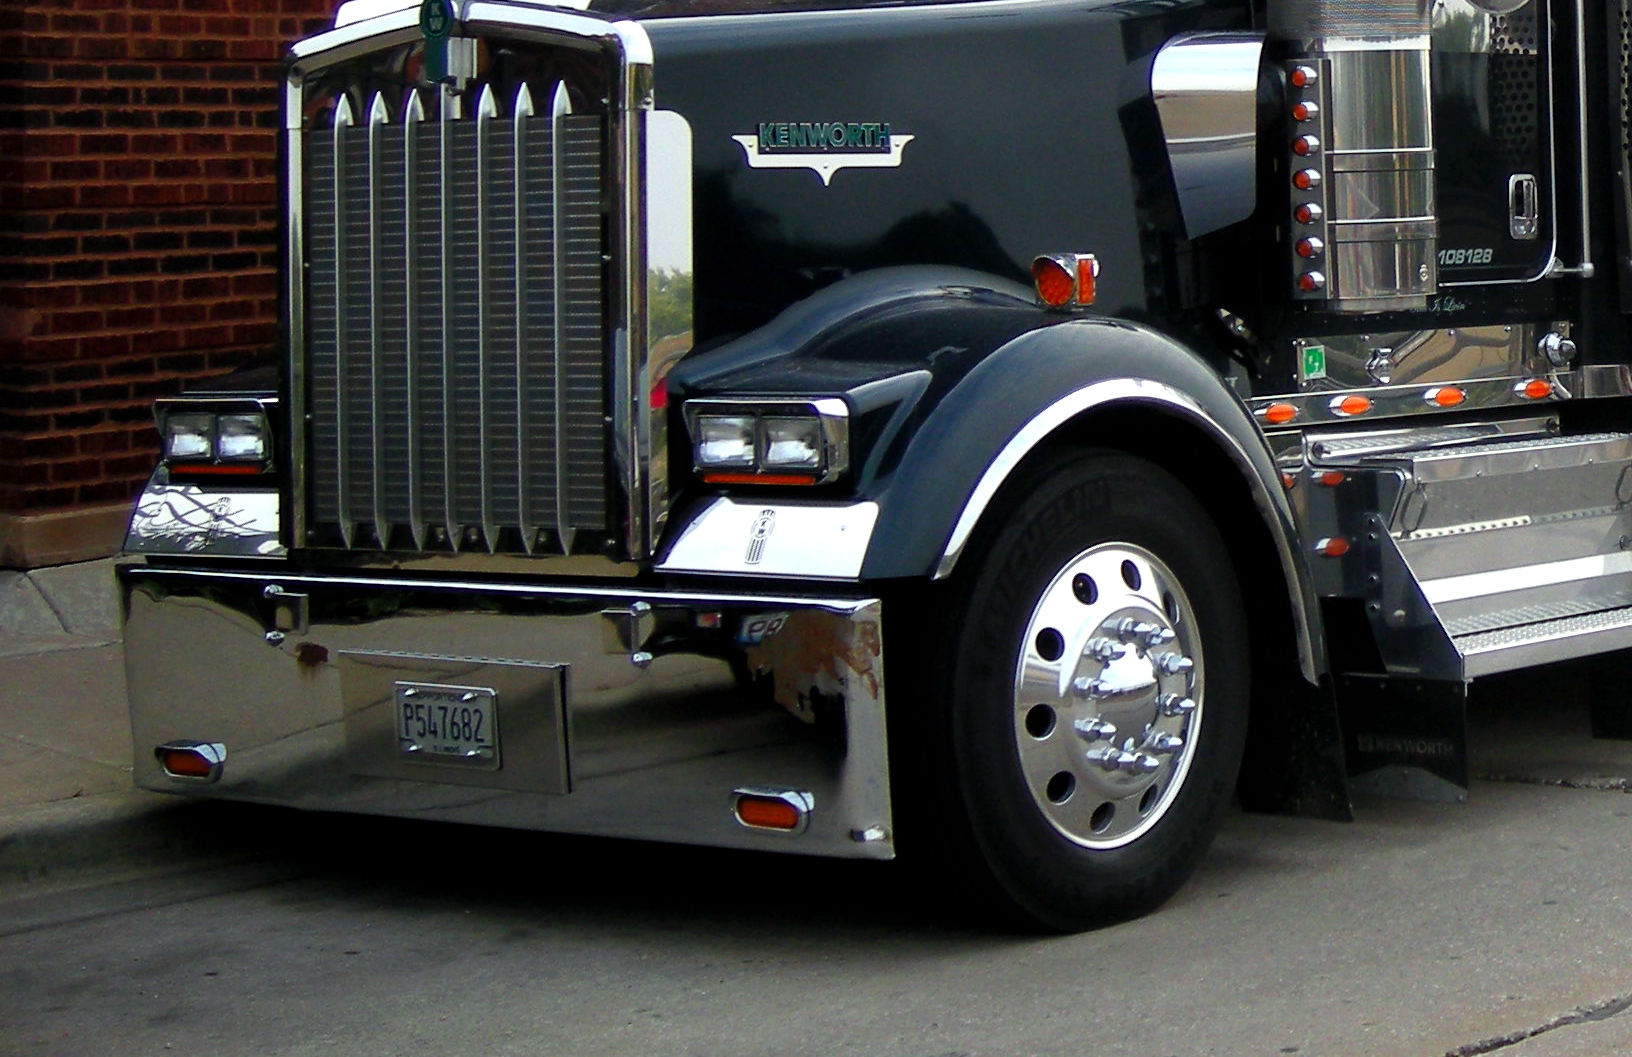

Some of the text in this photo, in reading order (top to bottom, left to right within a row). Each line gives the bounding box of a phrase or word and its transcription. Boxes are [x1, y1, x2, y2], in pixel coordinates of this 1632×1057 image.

[758, 121, 892, 149] KENWORTH
[1438, 248, 1493, 265] 108128
[402, 703, 485, 743] P547682
